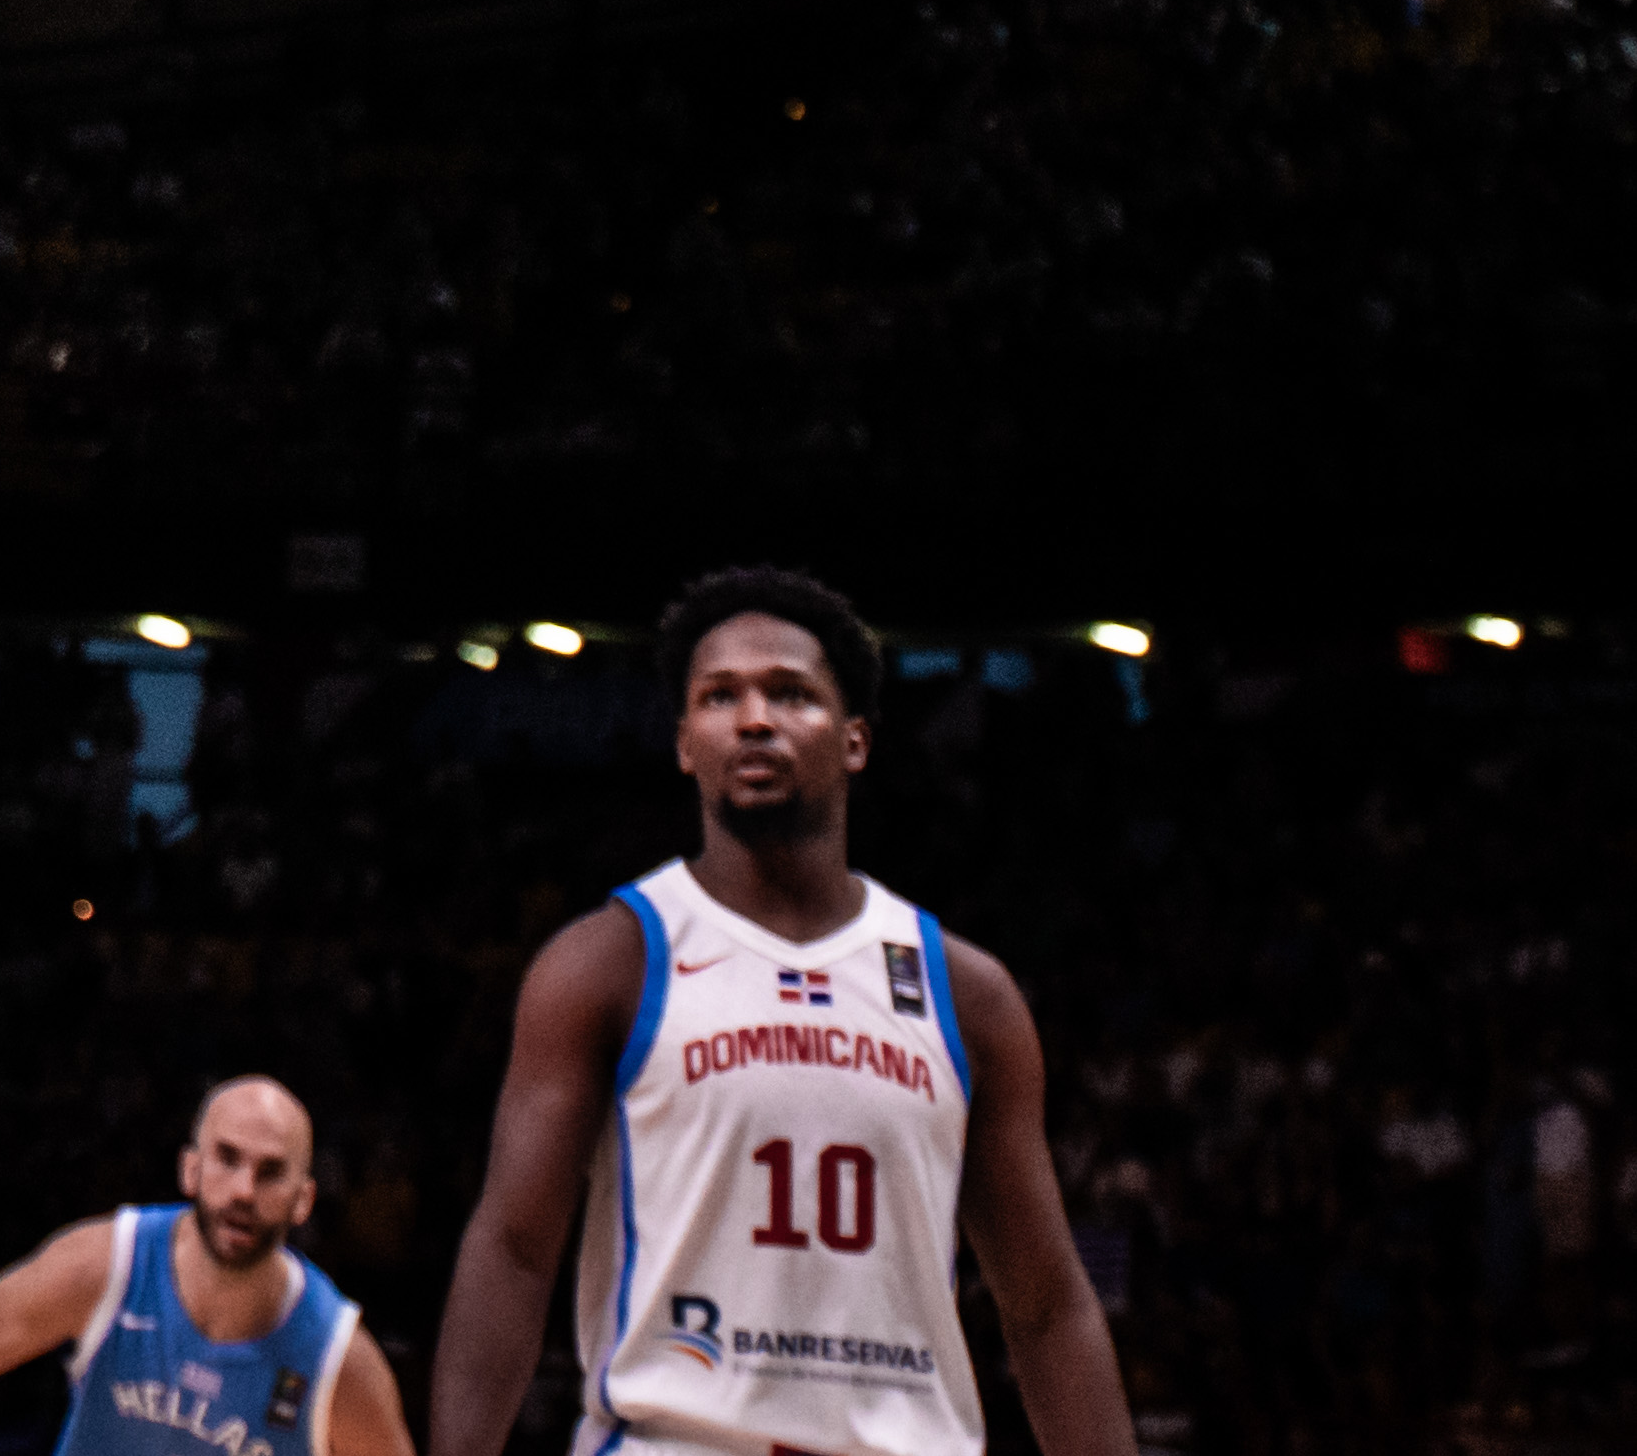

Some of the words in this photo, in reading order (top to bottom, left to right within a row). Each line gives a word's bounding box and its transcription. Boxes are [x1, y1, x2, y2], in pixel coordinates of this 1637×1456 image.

[683, 1022, 938, 1105] DOMINICANA
[751, 1137, 877, 1255] 10
[732, 1328, 935, 1376] BANRESERVAS
[112, 1379, 275, 1456] HELLA
